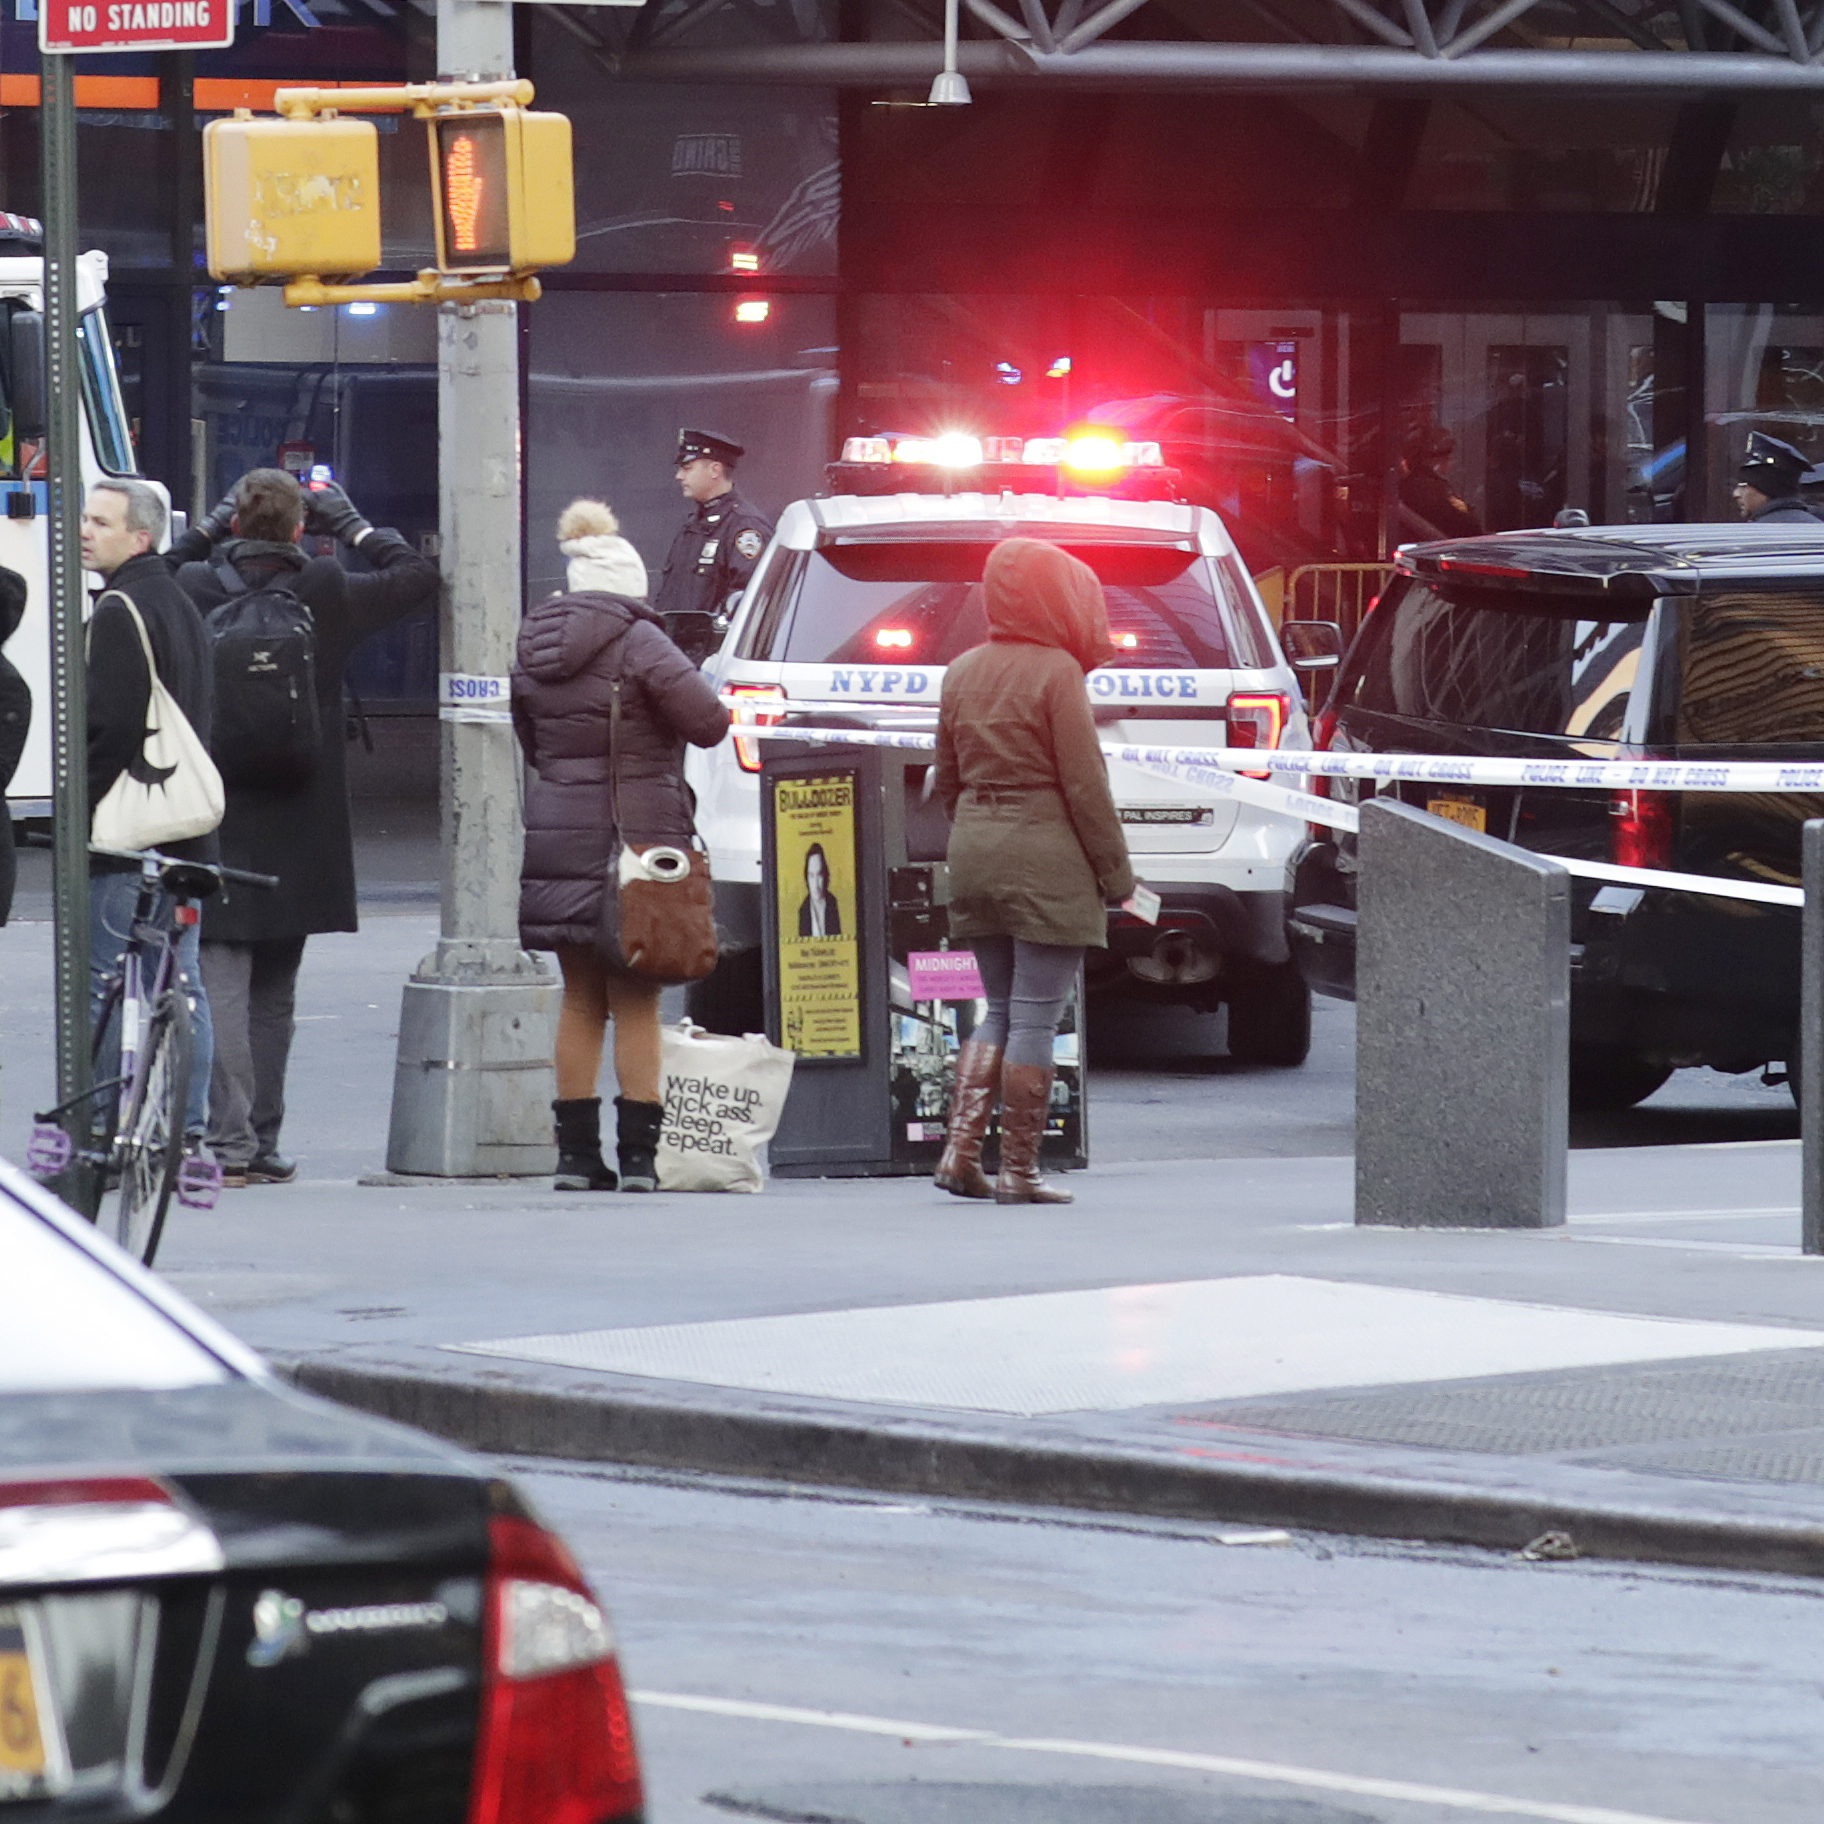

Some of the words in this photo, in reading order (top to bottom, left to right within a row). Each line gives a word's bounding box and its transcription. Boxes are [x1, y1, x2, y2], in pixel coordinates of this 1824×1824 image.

[68, 5, 96, 32] NO
[108, 1, 211, 31] STANDING
[830, 671, 928, 694] NYPD
[1085, 674, 1198, 698] OLICE
[780, 787, 850, 813] BULLDOZER
[1144, 810, 1193, 822] INSPIRES
[915, 957, 978, 972] MIDNIGHT
[665, 1089, 711, 1116] kick
[716, 1104, 756, 1124] ass.
[667, 1075, 729, 1100] wake
[734, 1087, 764, 1110] up.
[660, 1108, 726, 1138] sleep.
